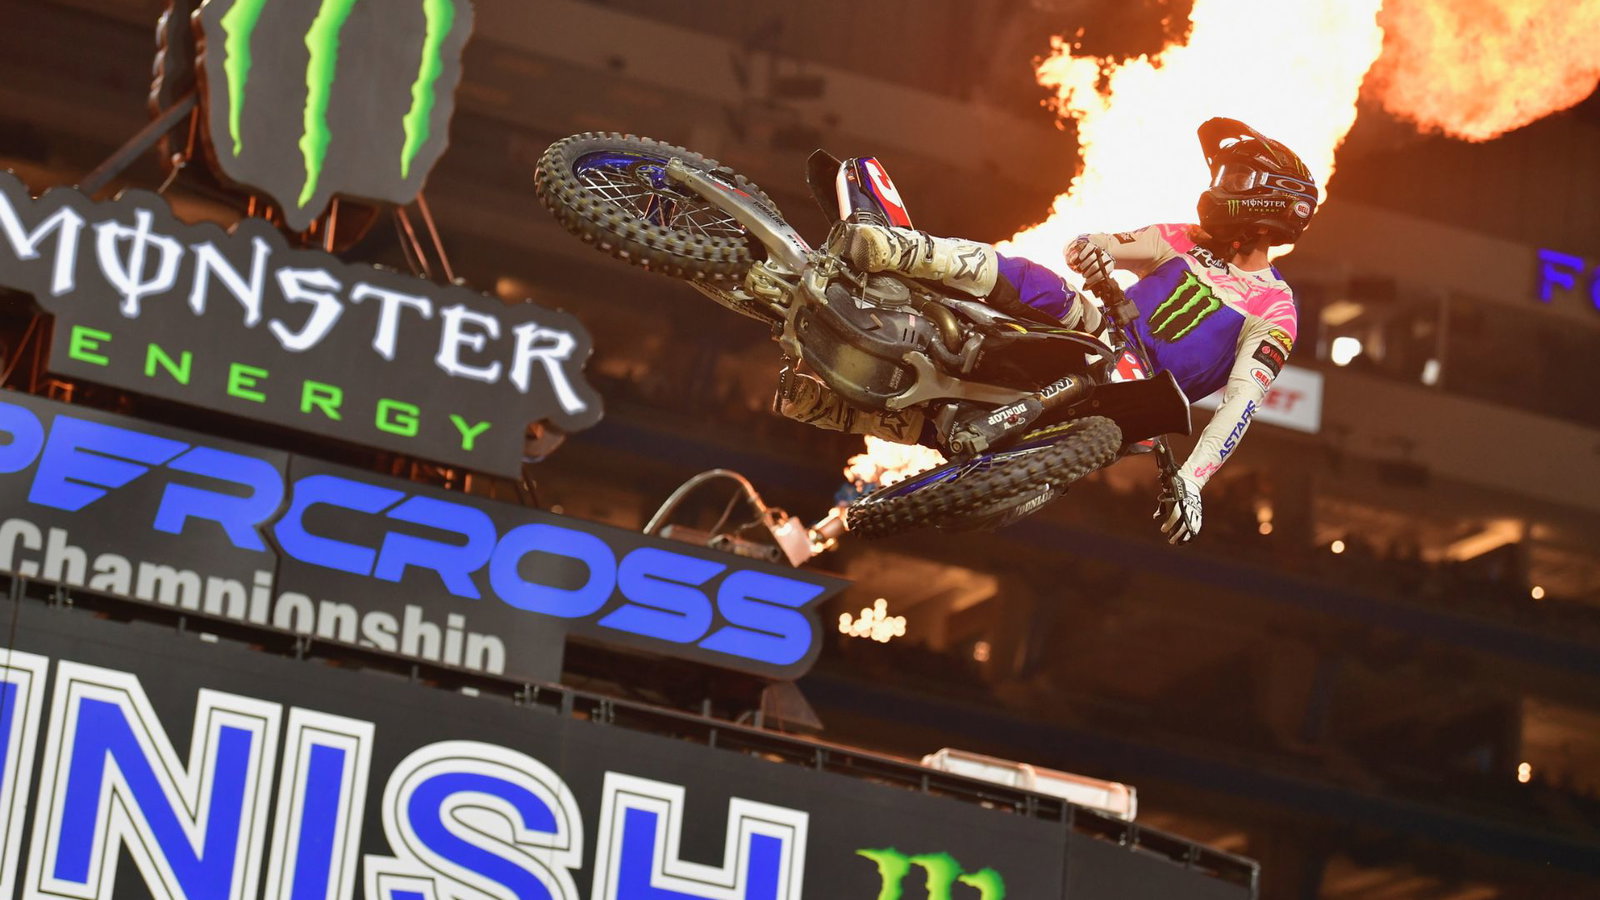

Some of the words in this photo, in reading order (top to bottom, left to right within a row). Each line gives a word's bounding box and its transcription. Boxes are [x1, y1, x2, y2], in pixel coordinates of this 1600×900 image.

[1241, 199, 1287, 208] MONSTER
[69, 326, 491, 450] ENERGY
[988, 402, 1028, 426] DUNLOP
[1017, 489, 1055, 516] DUNLOP
